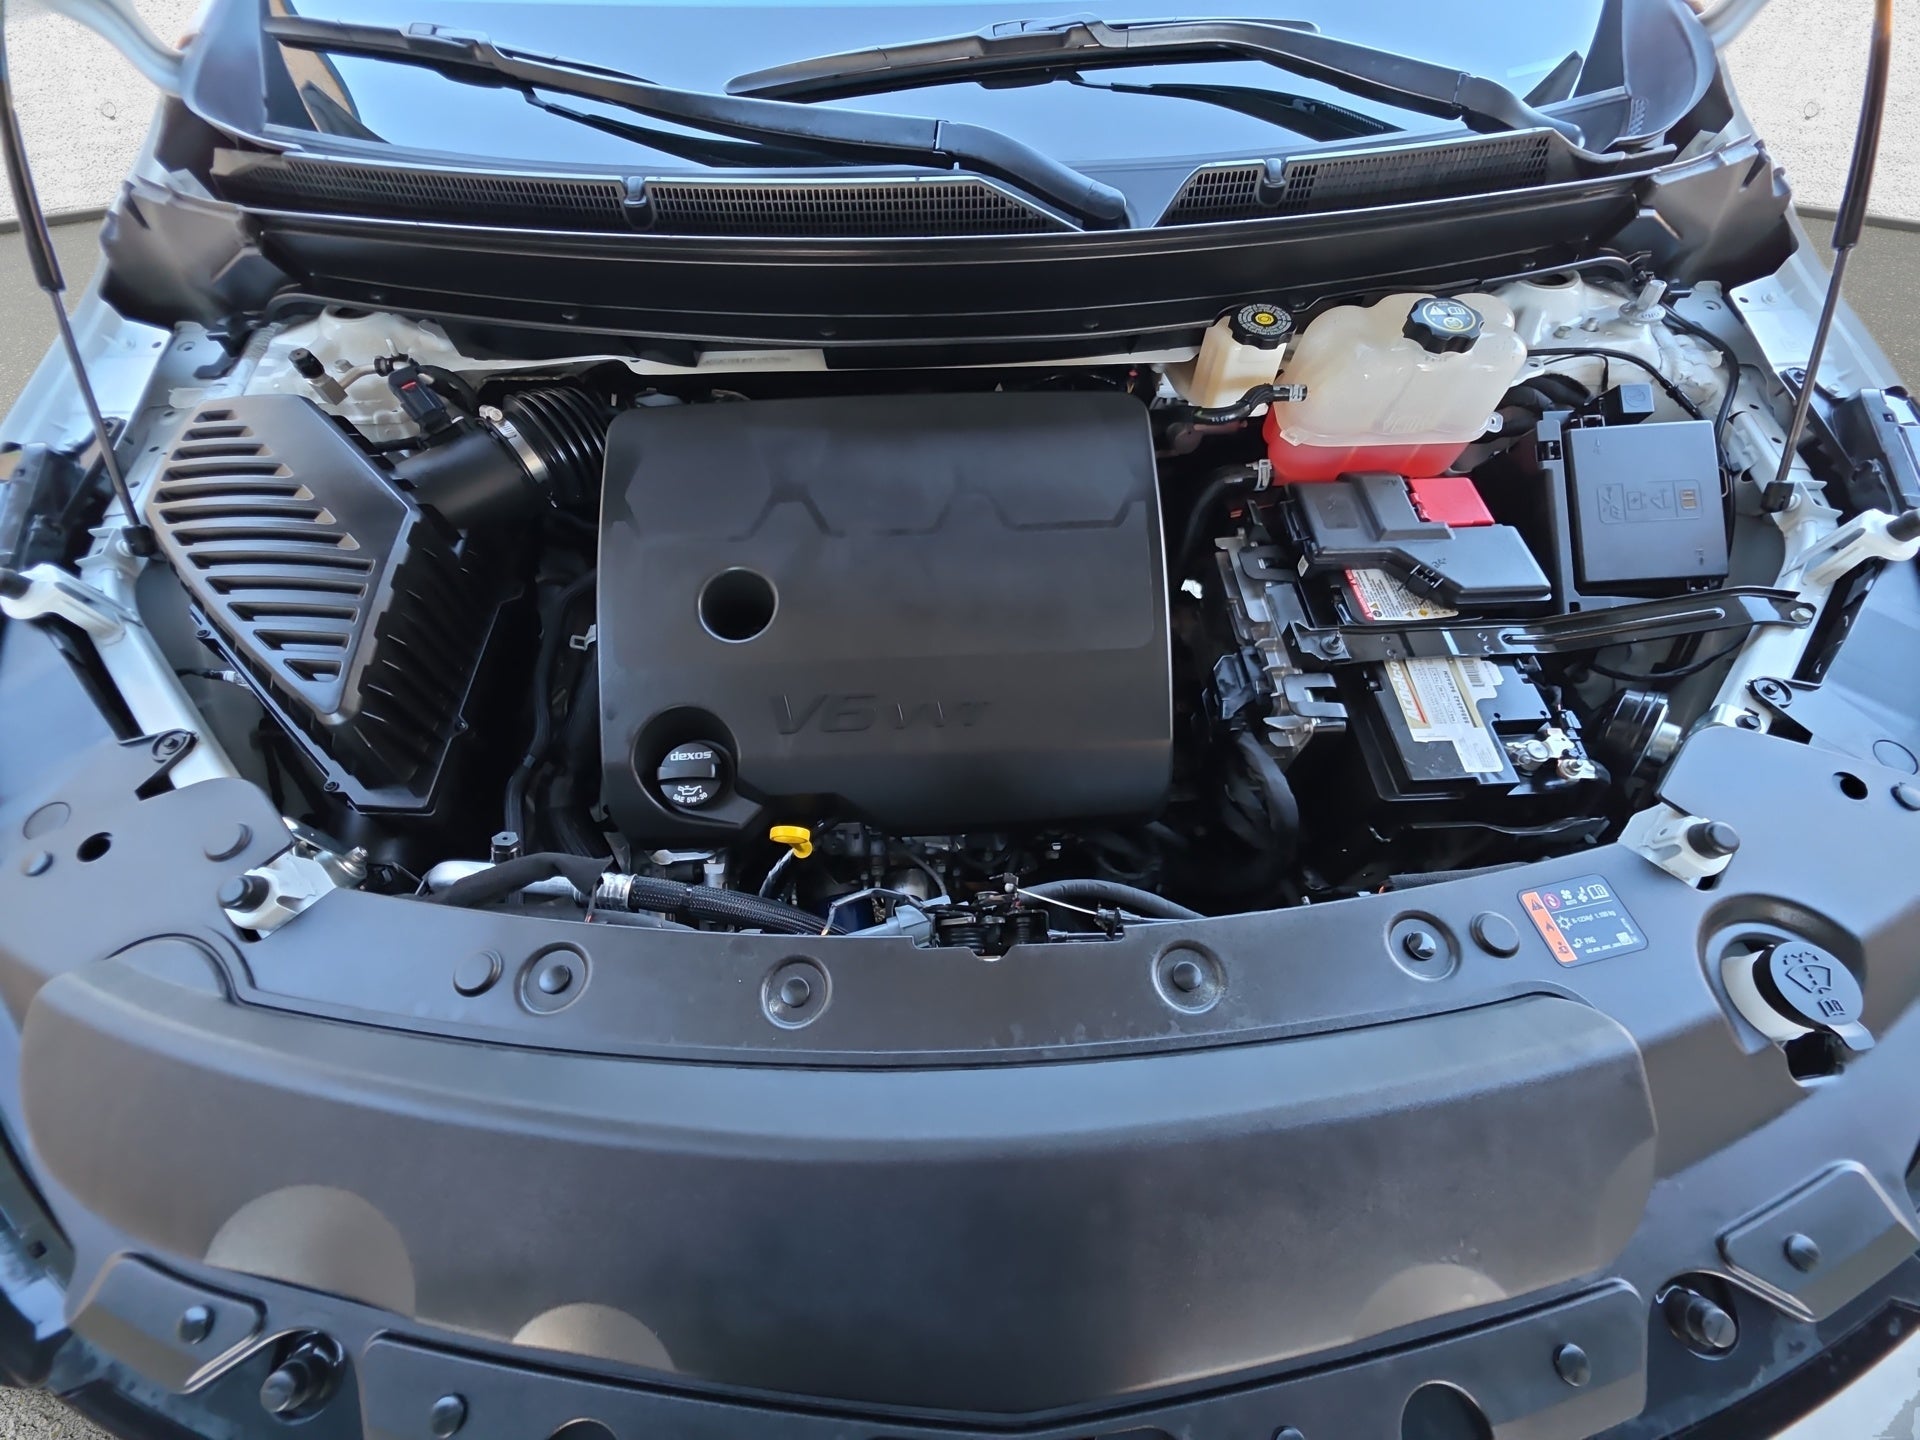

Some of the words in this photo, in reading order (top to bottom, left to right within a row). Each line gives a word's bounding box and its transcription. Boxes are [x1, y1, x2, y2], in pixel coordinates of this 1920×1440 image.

[768, 692, 879, 735] V6
[670, 750, 713, 761] dexos
[672, 793, 685, 803] SAE
[686, 791, 708, 803] 5W-30
